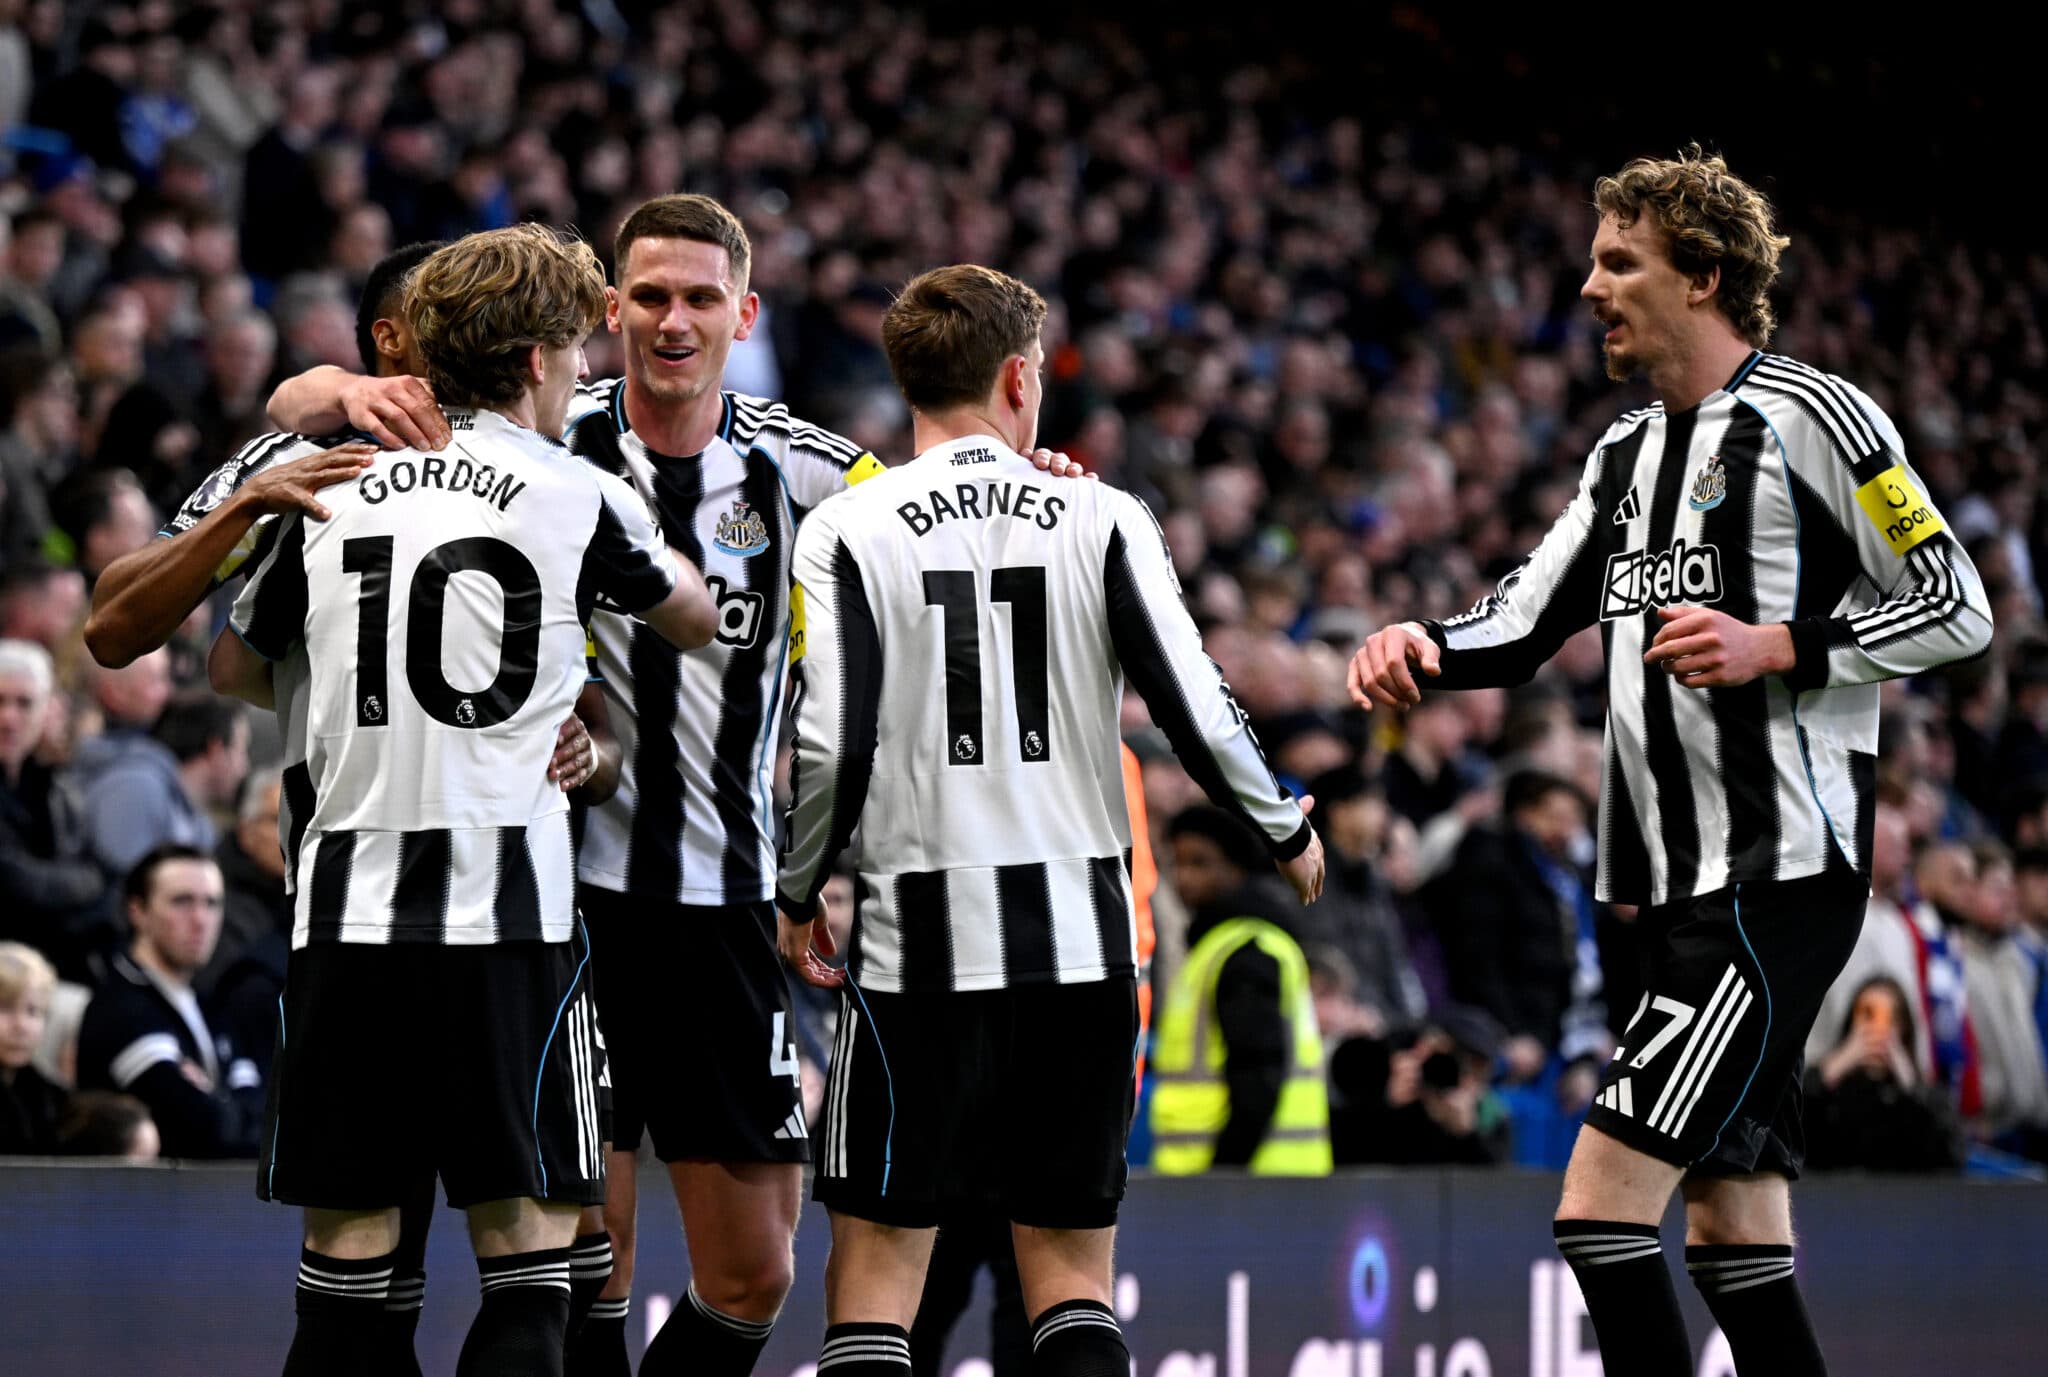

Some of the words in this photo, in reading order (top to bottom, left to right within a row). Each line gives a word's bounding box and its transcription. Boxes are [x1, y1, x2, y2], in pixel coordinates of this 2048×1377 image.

[949, 458, 970, 467] THE
[971, 454, 997, 464] LADS
[953, 447, 989, 460] HOWAY
[359, 457, 527, 512] GORDON
[896, 482, 1066, 538] BARNES
[1886, 506, 1934, 542] noon
[342, 535, 543, 729] 10
[922, 566, 1050, 766] 11
